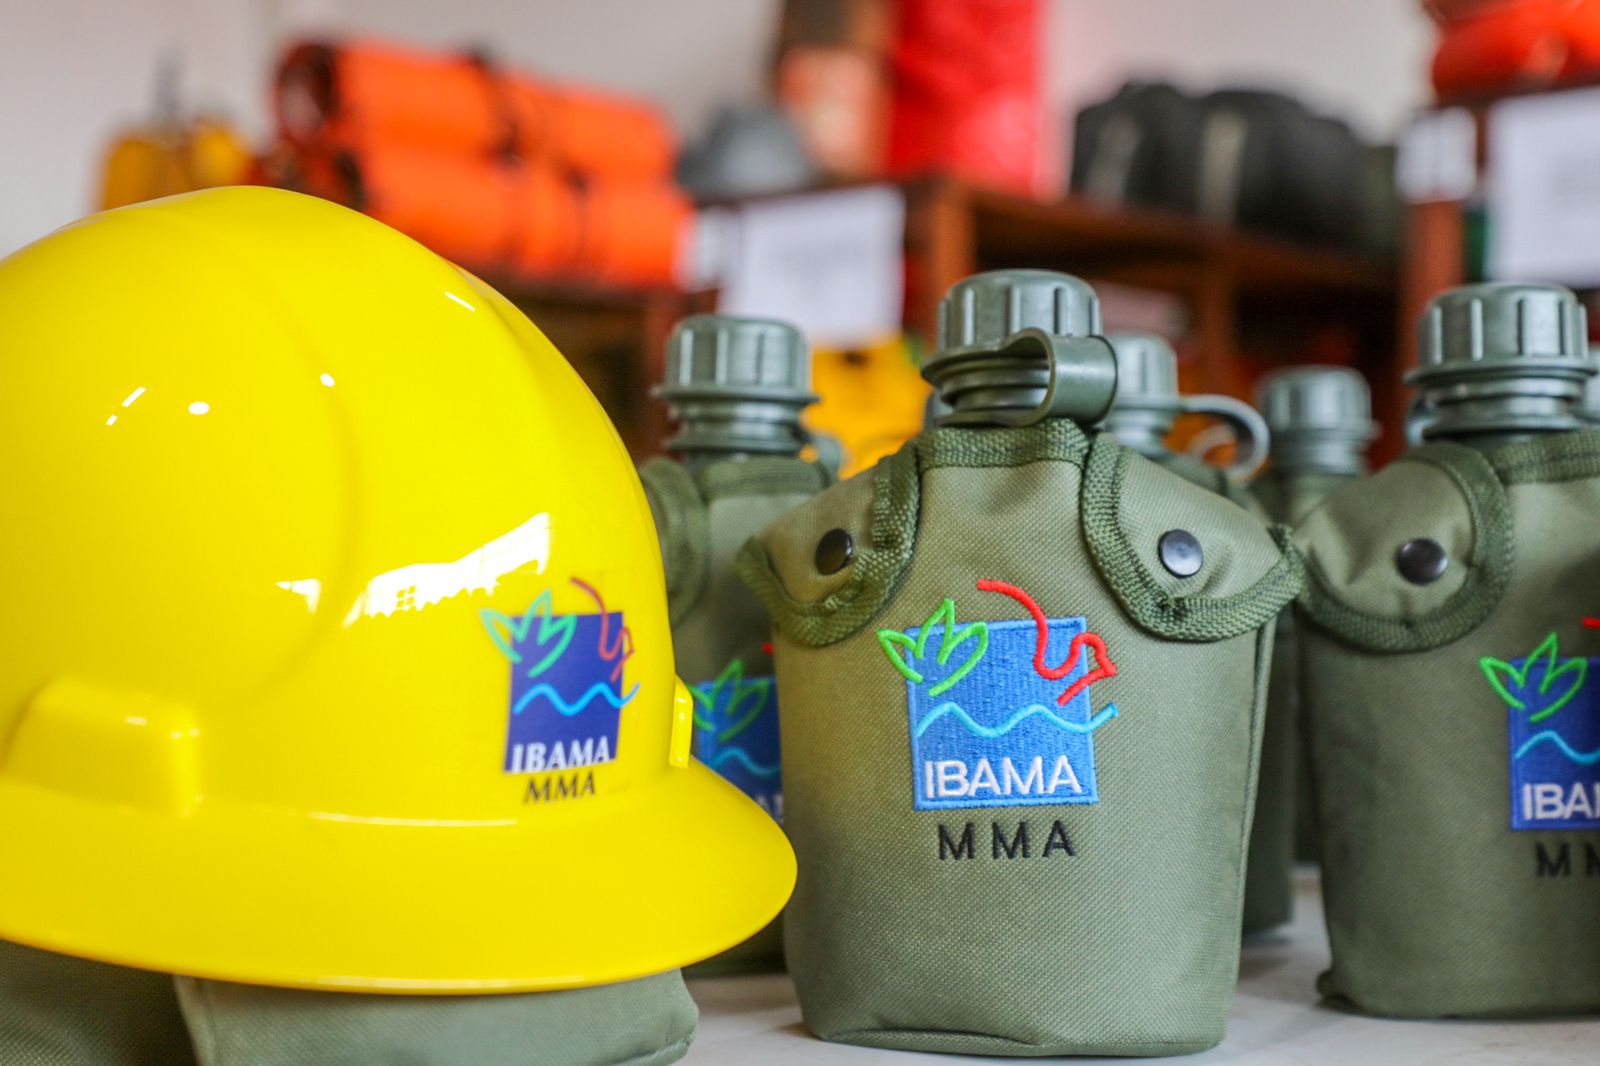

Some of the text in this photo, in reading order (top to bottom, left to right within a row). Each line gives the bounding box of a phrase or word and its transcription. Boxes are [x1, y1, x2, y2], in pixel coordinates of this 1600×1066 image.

[510, 735, 611, 774] IBAMA
[523, 770, 596, 805] MMA
[925, 754, 1083, 799] IBAMA
[1522, 782, 1600, 821] IBA
[938, 819, 1077, 860] MMA
